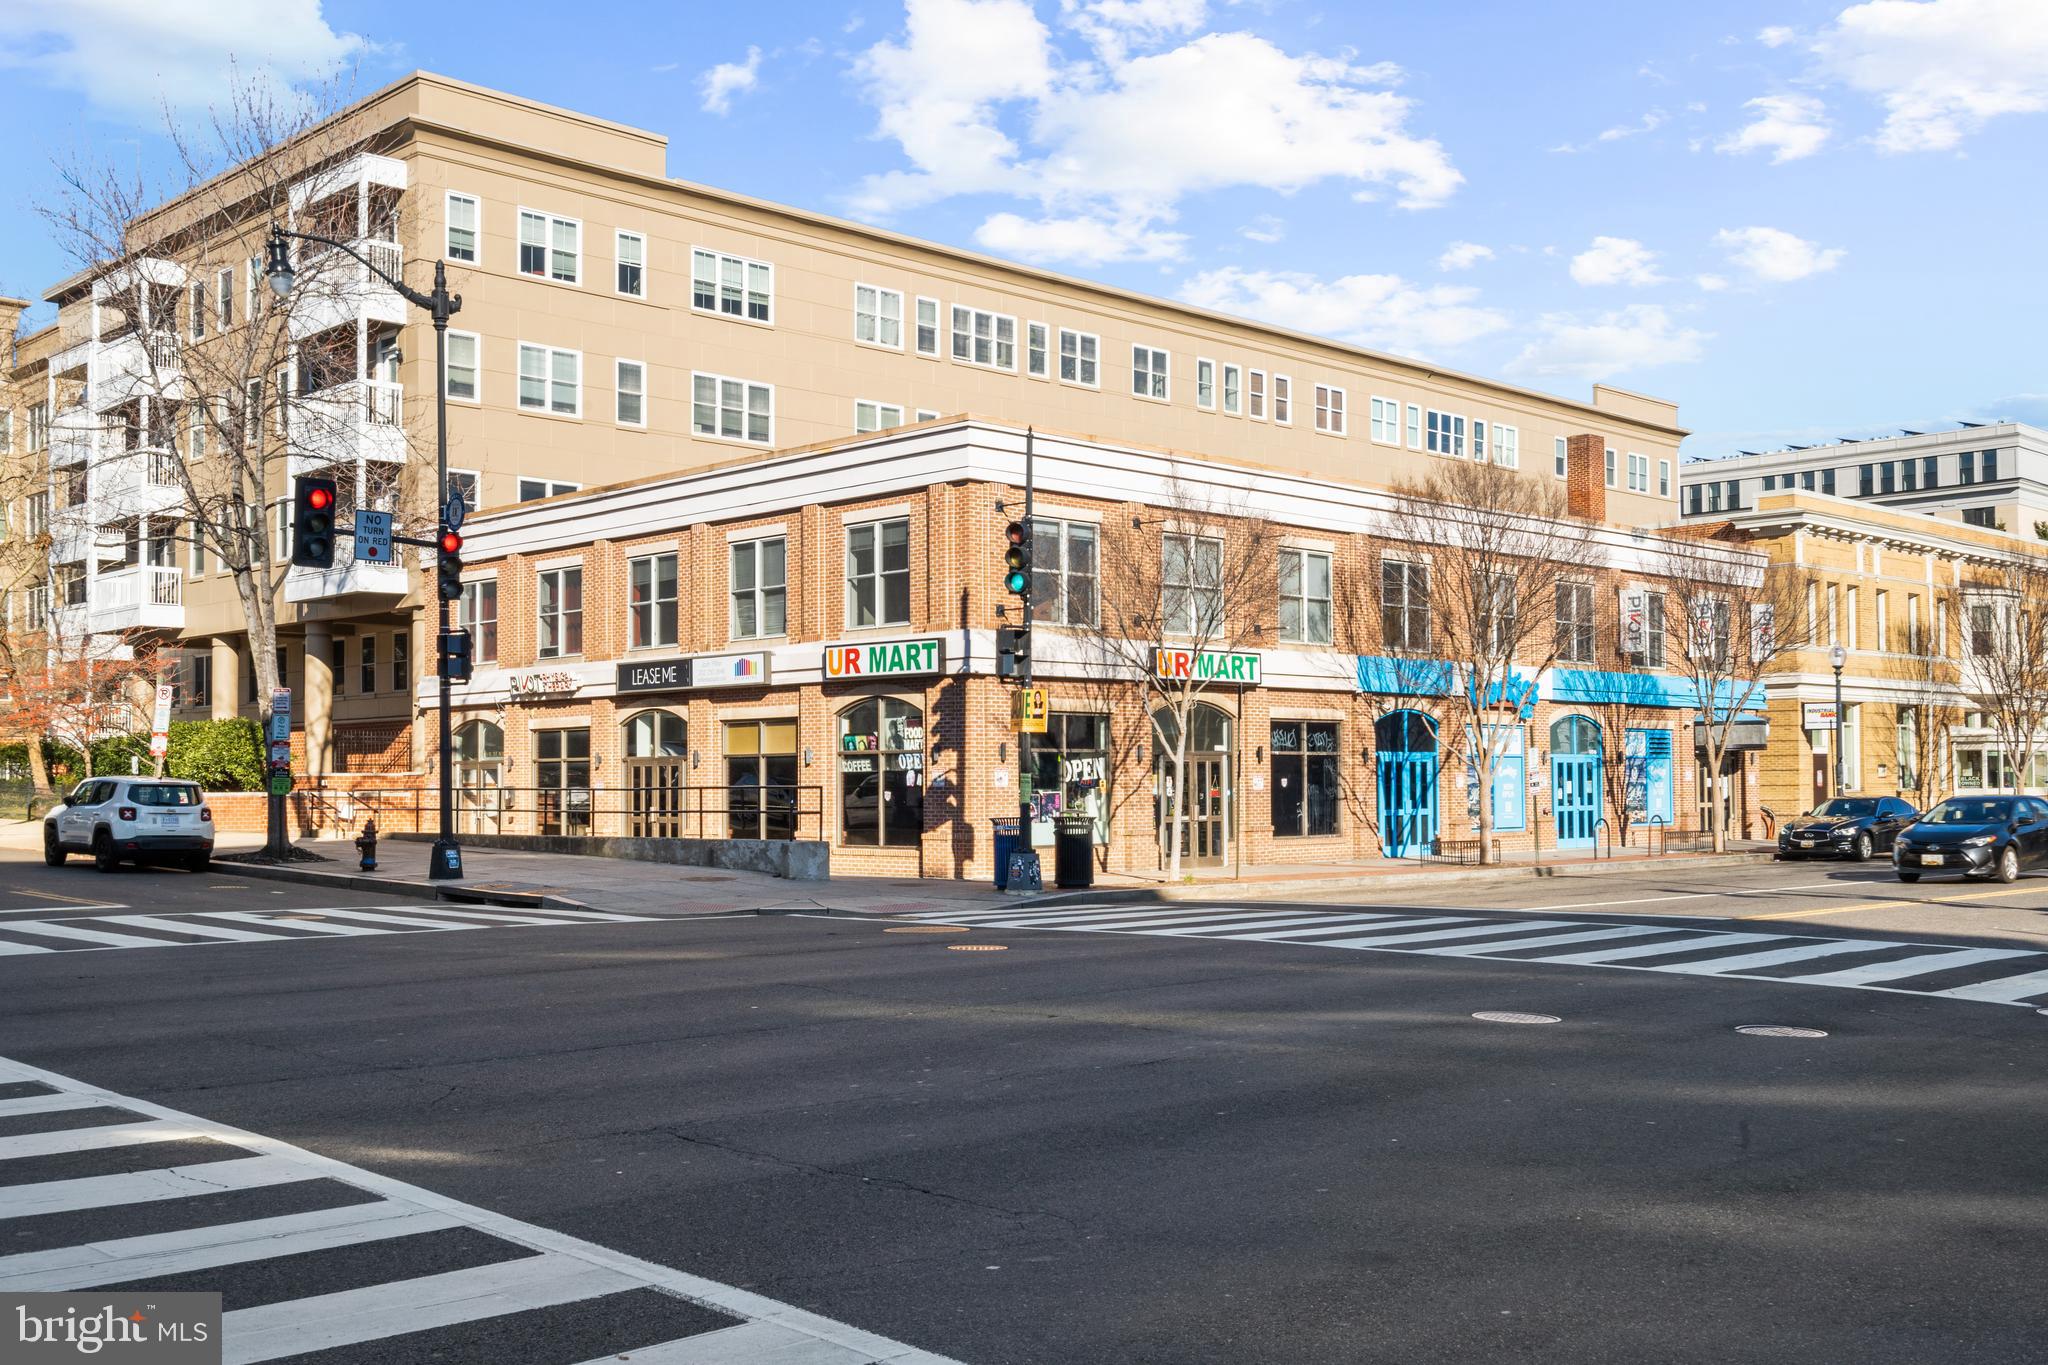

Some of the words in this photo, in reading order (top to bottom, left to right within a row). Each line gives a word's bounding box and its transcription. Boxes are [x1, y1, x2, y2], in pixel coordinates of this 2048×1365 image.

[366, 514, 382, 525] NO
[363, 526, 384, 535] TURN
[358, 535, 370, 544] ON
[372, 537, 388, 546] RED
[1628, 596, 1642, 644] PIVOT
[828, 648, 861, 675] UR
[869, 642, 937, 673] MART
[1157, 651, 1190, 677] UR
[1197, 654, 1258, 680] MART
[510, 674, 541, 694] PIVOT
[631, 667, 661, 686] LEASE
[662, 665, 677, 683] ME
[904, 727, 923, 739] FOOD
[903, 738, 923, 751] MART
[841, 759, 873, 773] COFFEE
[898, 753, 924, 770] OPE
[1064, 757, 1105, 783] OPEN
